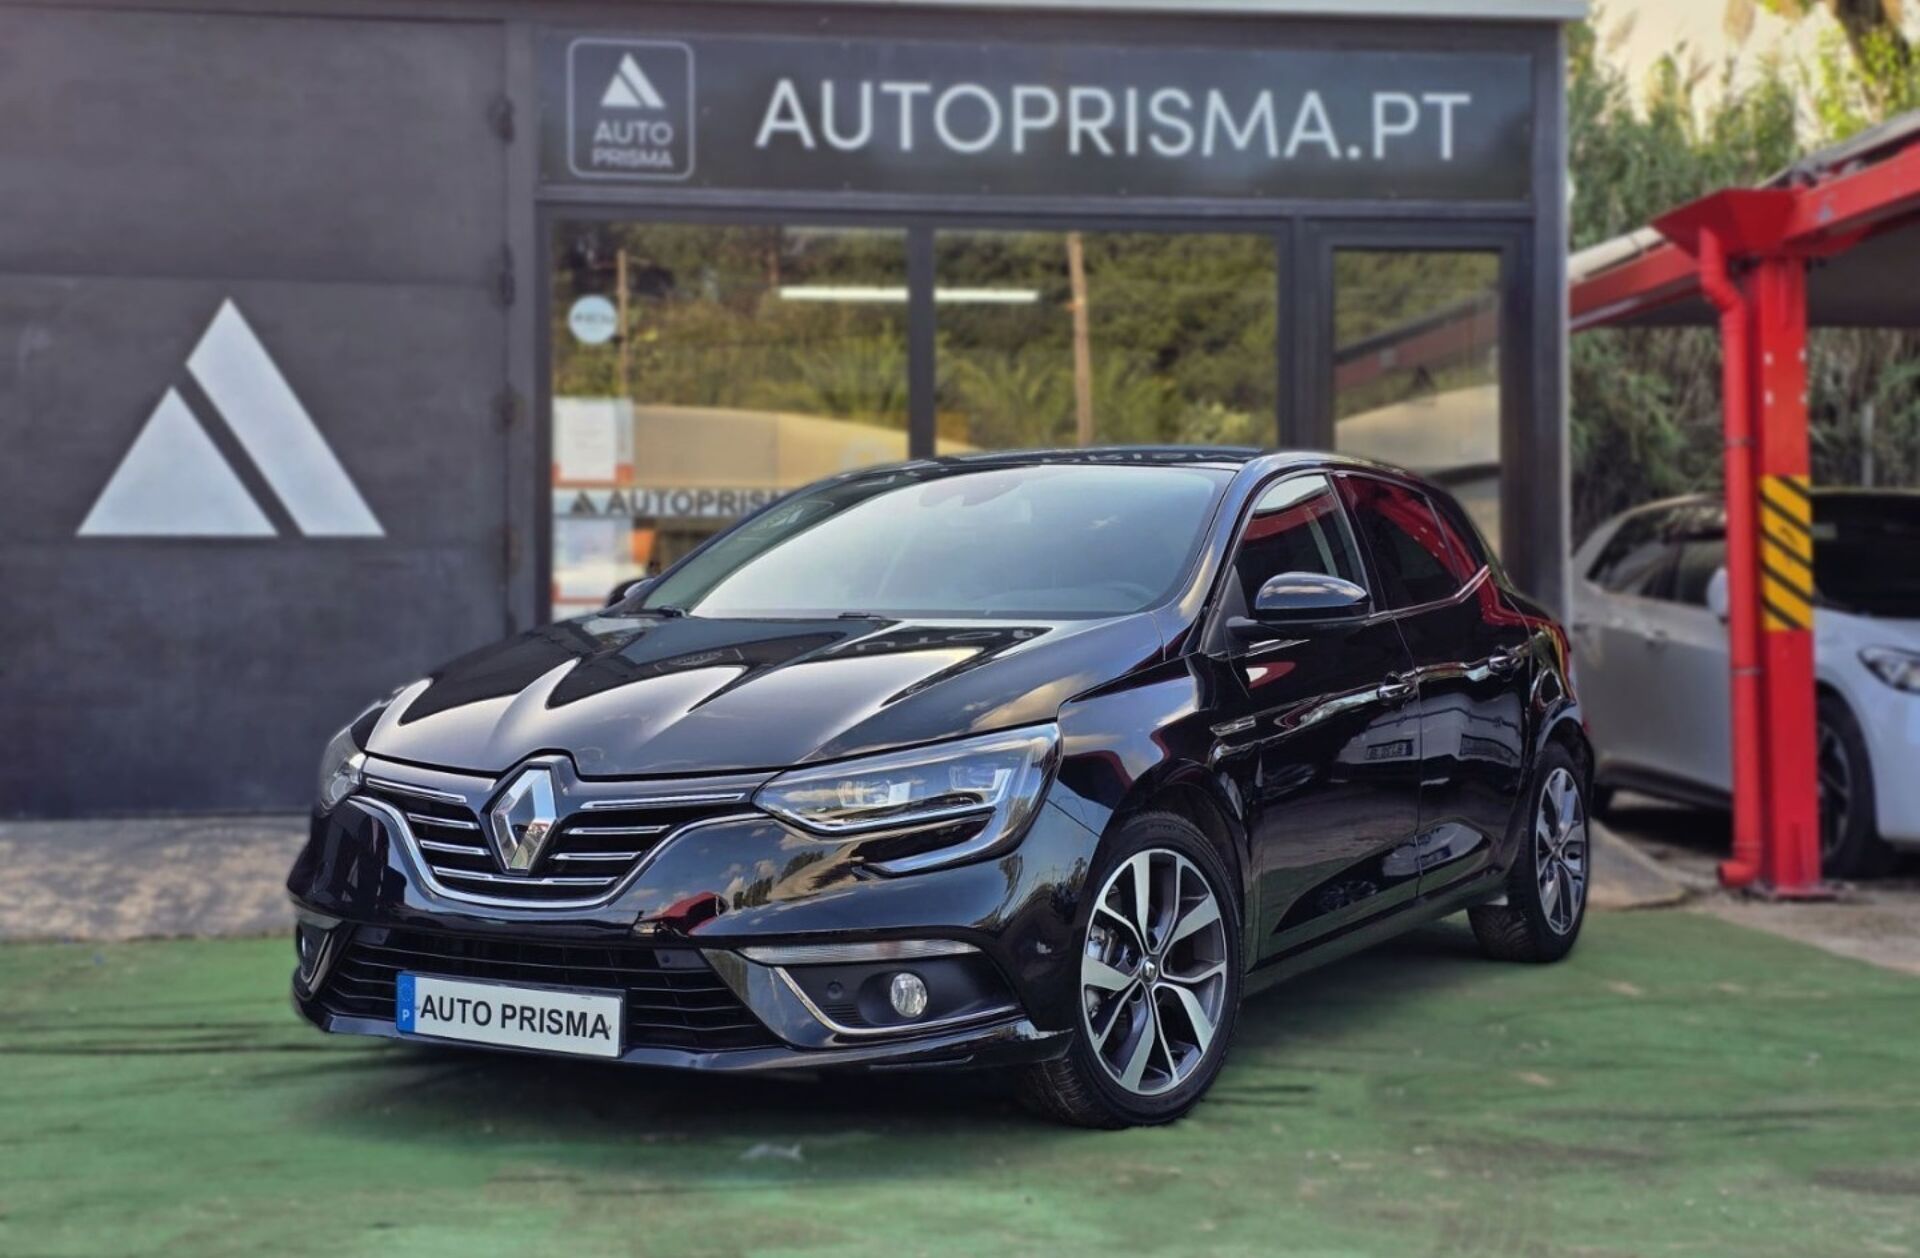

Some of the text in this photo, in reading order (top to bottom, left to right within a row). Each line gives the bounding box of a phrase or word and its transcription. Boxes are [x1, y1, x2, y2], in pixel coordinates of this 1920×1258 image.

[592, 119, 674, 145] AUTO
[754, 78, 1472, 161] AUTOPRISMA.PT
[402, 1009, 411, 1022] P
[420, 994, 611, 1041] AUTO PRISMA
